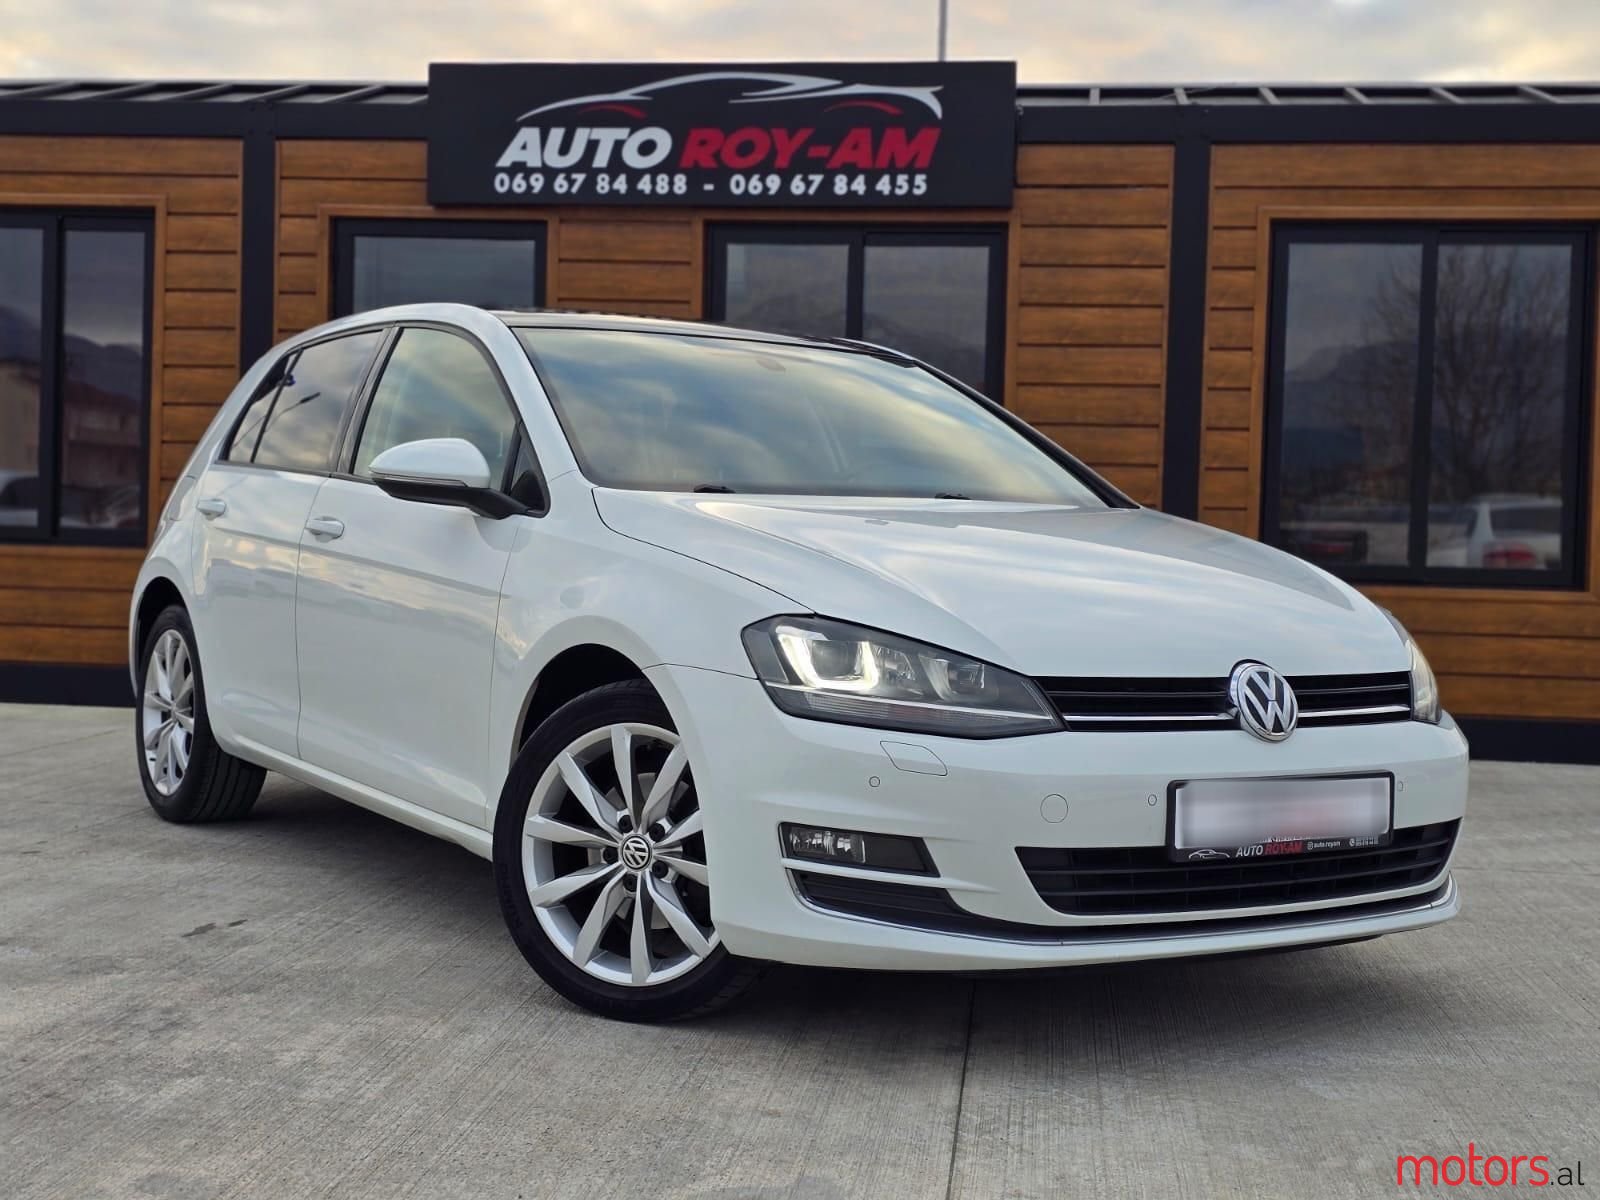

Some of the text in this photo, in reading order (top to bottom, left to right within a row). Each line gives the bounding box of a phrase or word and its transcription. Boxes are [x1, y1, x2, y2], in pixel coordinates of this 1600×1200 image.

[495, 127, 942, 169] AUTO ROY-AM
[494, 172, 927, 195] 069 67 84 488 - 069 67 84 455
[1235, 844, 1264, 858] AUTO
